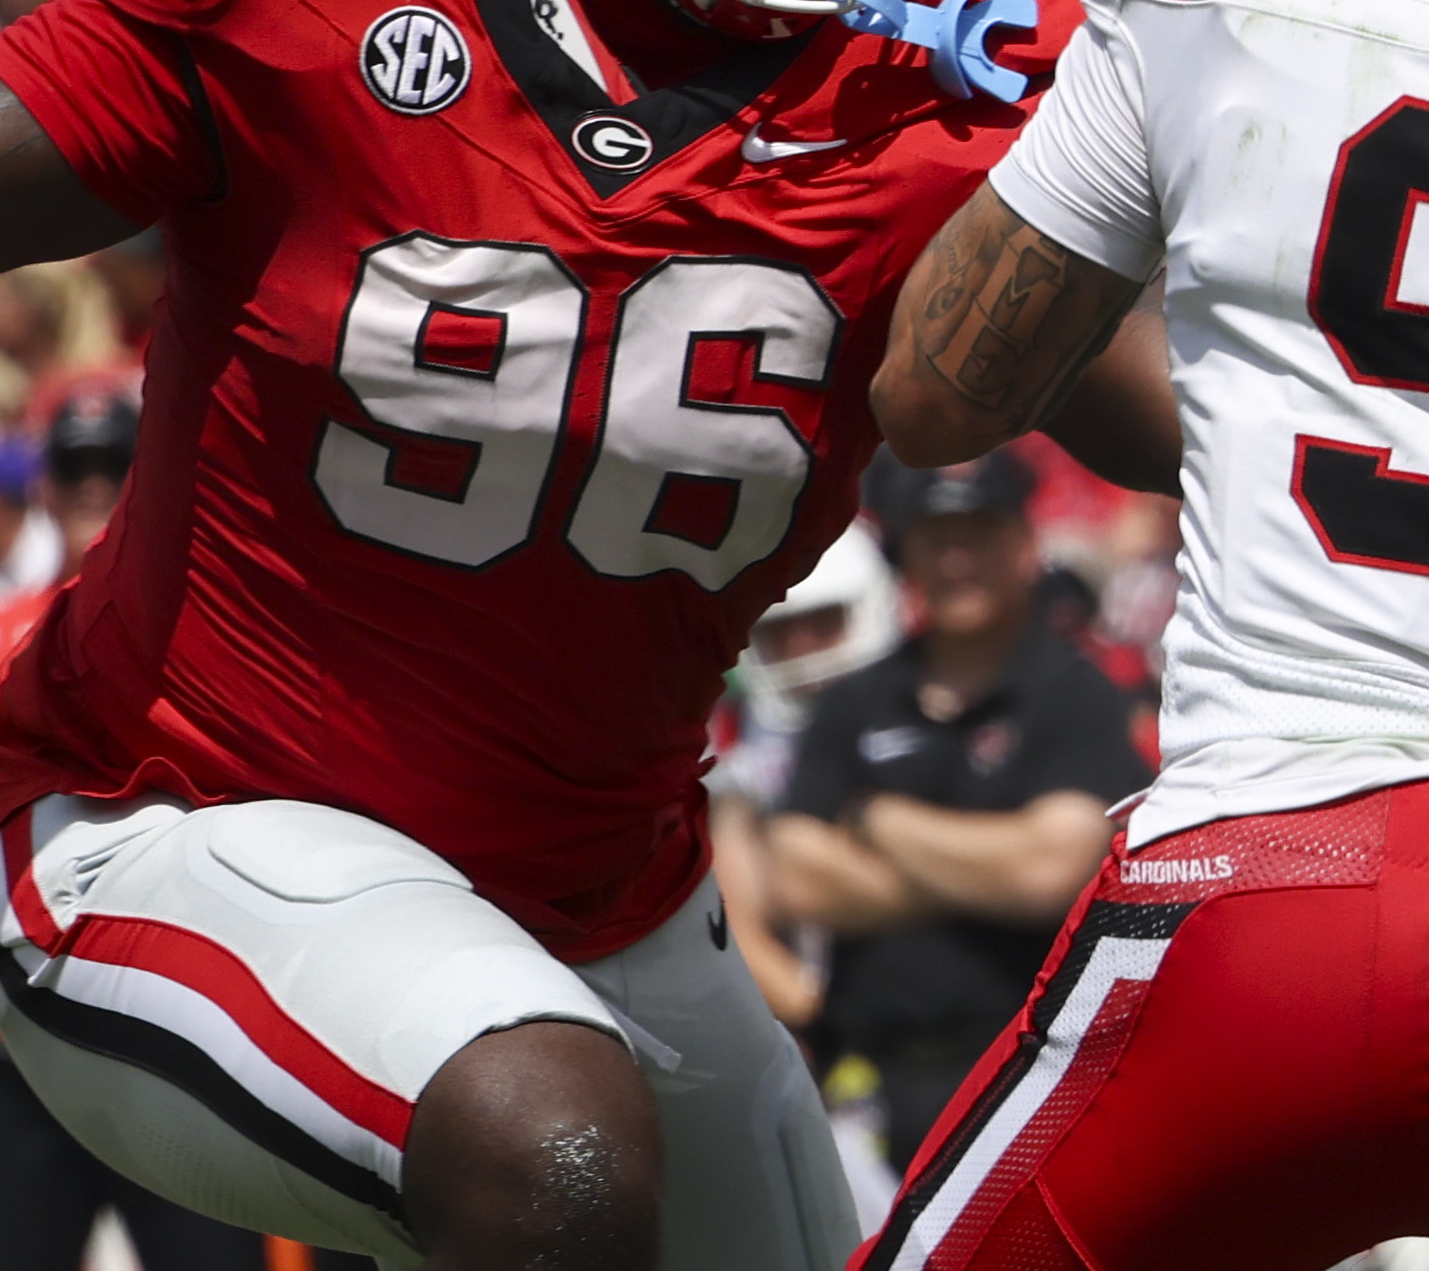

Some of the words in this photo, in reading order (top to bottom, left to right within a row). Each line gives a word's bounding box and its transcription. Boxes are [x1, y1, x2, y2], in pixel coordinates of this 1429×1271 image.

[371, 13, 460, 107] SEC
[573, 117, 653, 170] G
[312, 228, 848, 595] 96
[1119, 853, 1234, 885] CARDINALS
